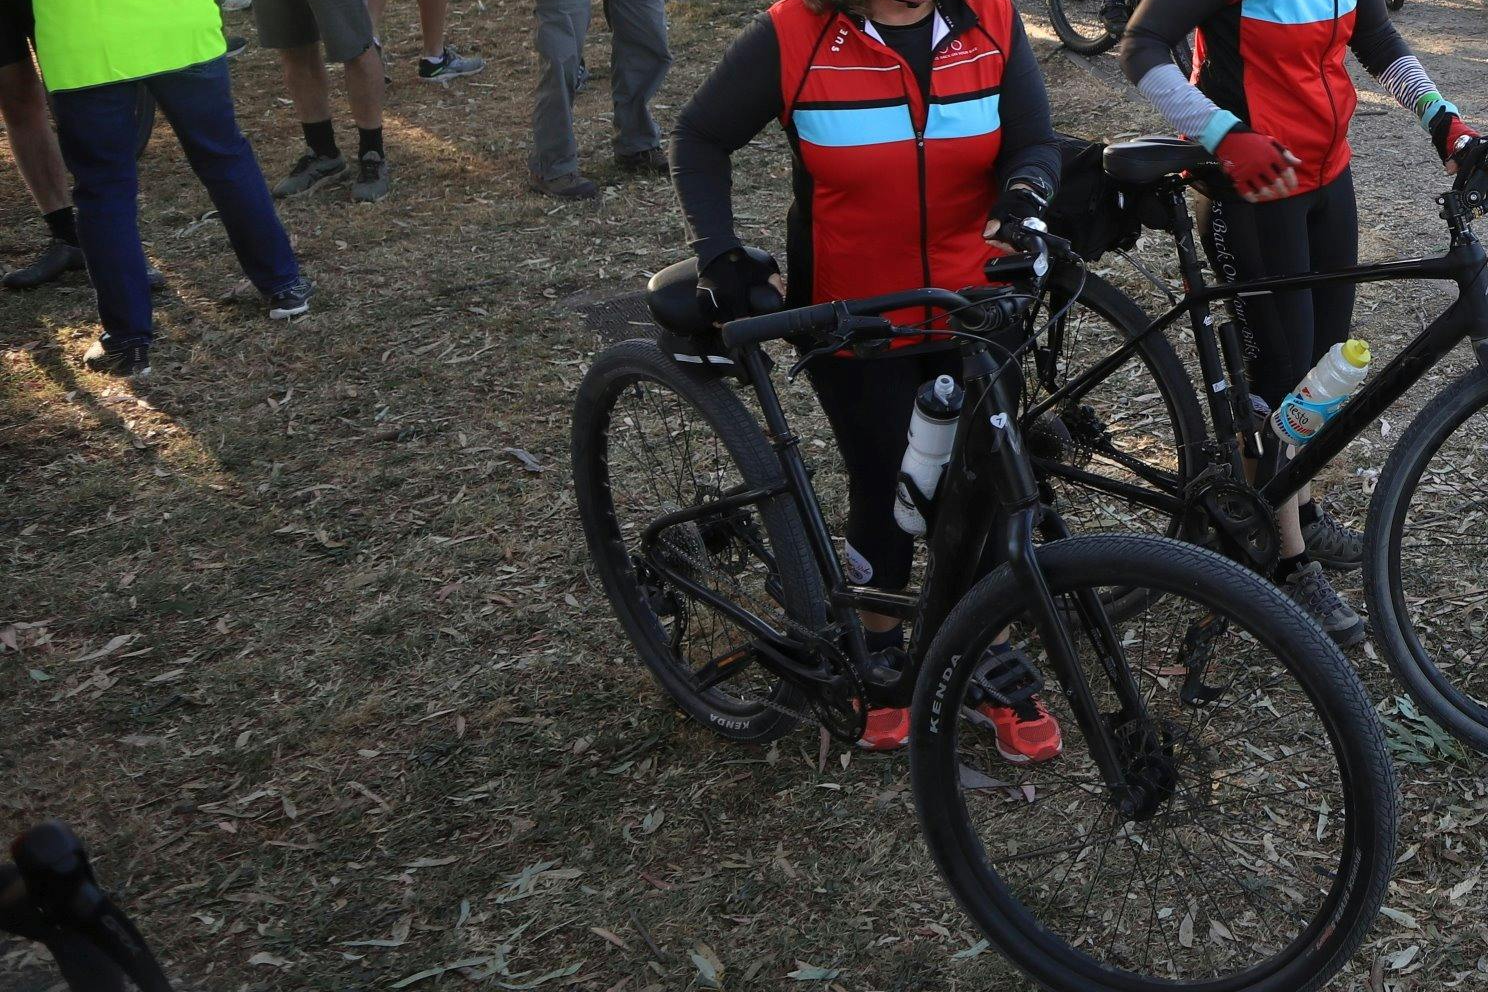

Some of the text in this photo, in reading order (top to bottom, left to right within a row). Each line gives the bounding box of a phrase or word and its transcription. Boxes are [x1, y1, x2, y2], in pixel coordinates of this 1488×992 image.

[831, 28, 849, 52] SUE
[1213, 218, 1235, 261] Back
[929, 654, 963, 734] KENDA
